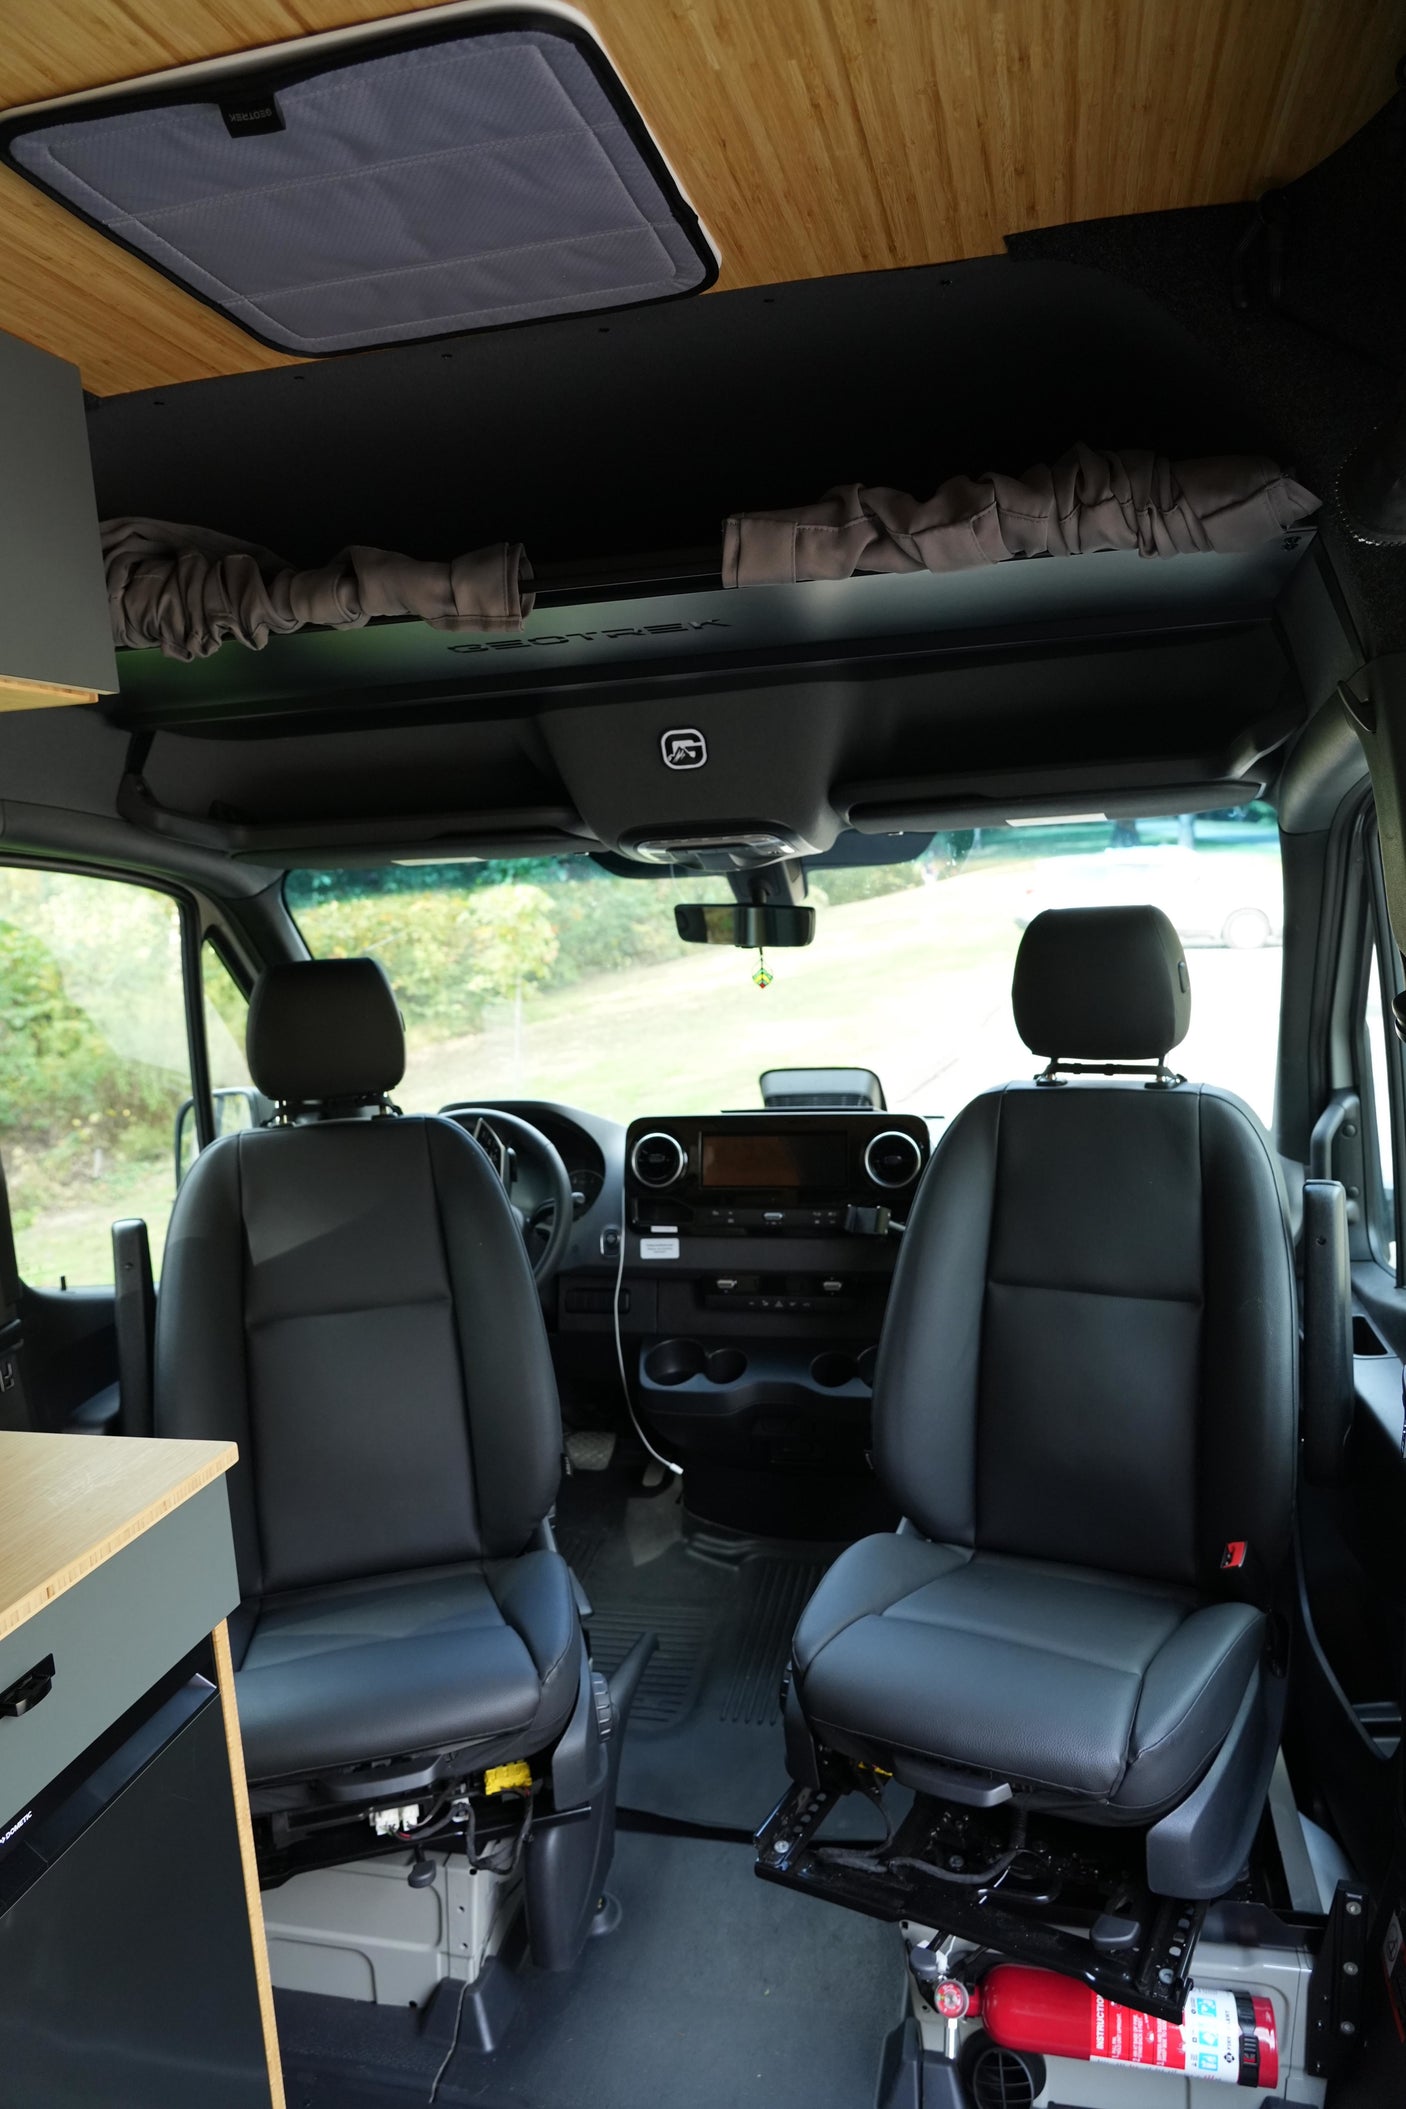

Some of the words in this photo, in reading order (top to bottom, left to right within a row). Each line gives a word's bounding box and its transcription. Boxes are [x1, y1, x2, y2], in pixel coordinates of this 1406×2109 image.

[228, 108, 273, 122] GEOTREK
[447, 619, 732, 653] GEOTREK
[6, 1811, 32, 1840] DOMETIC
[1095, 1994, 1105, 2050] INSTRUCTIO
